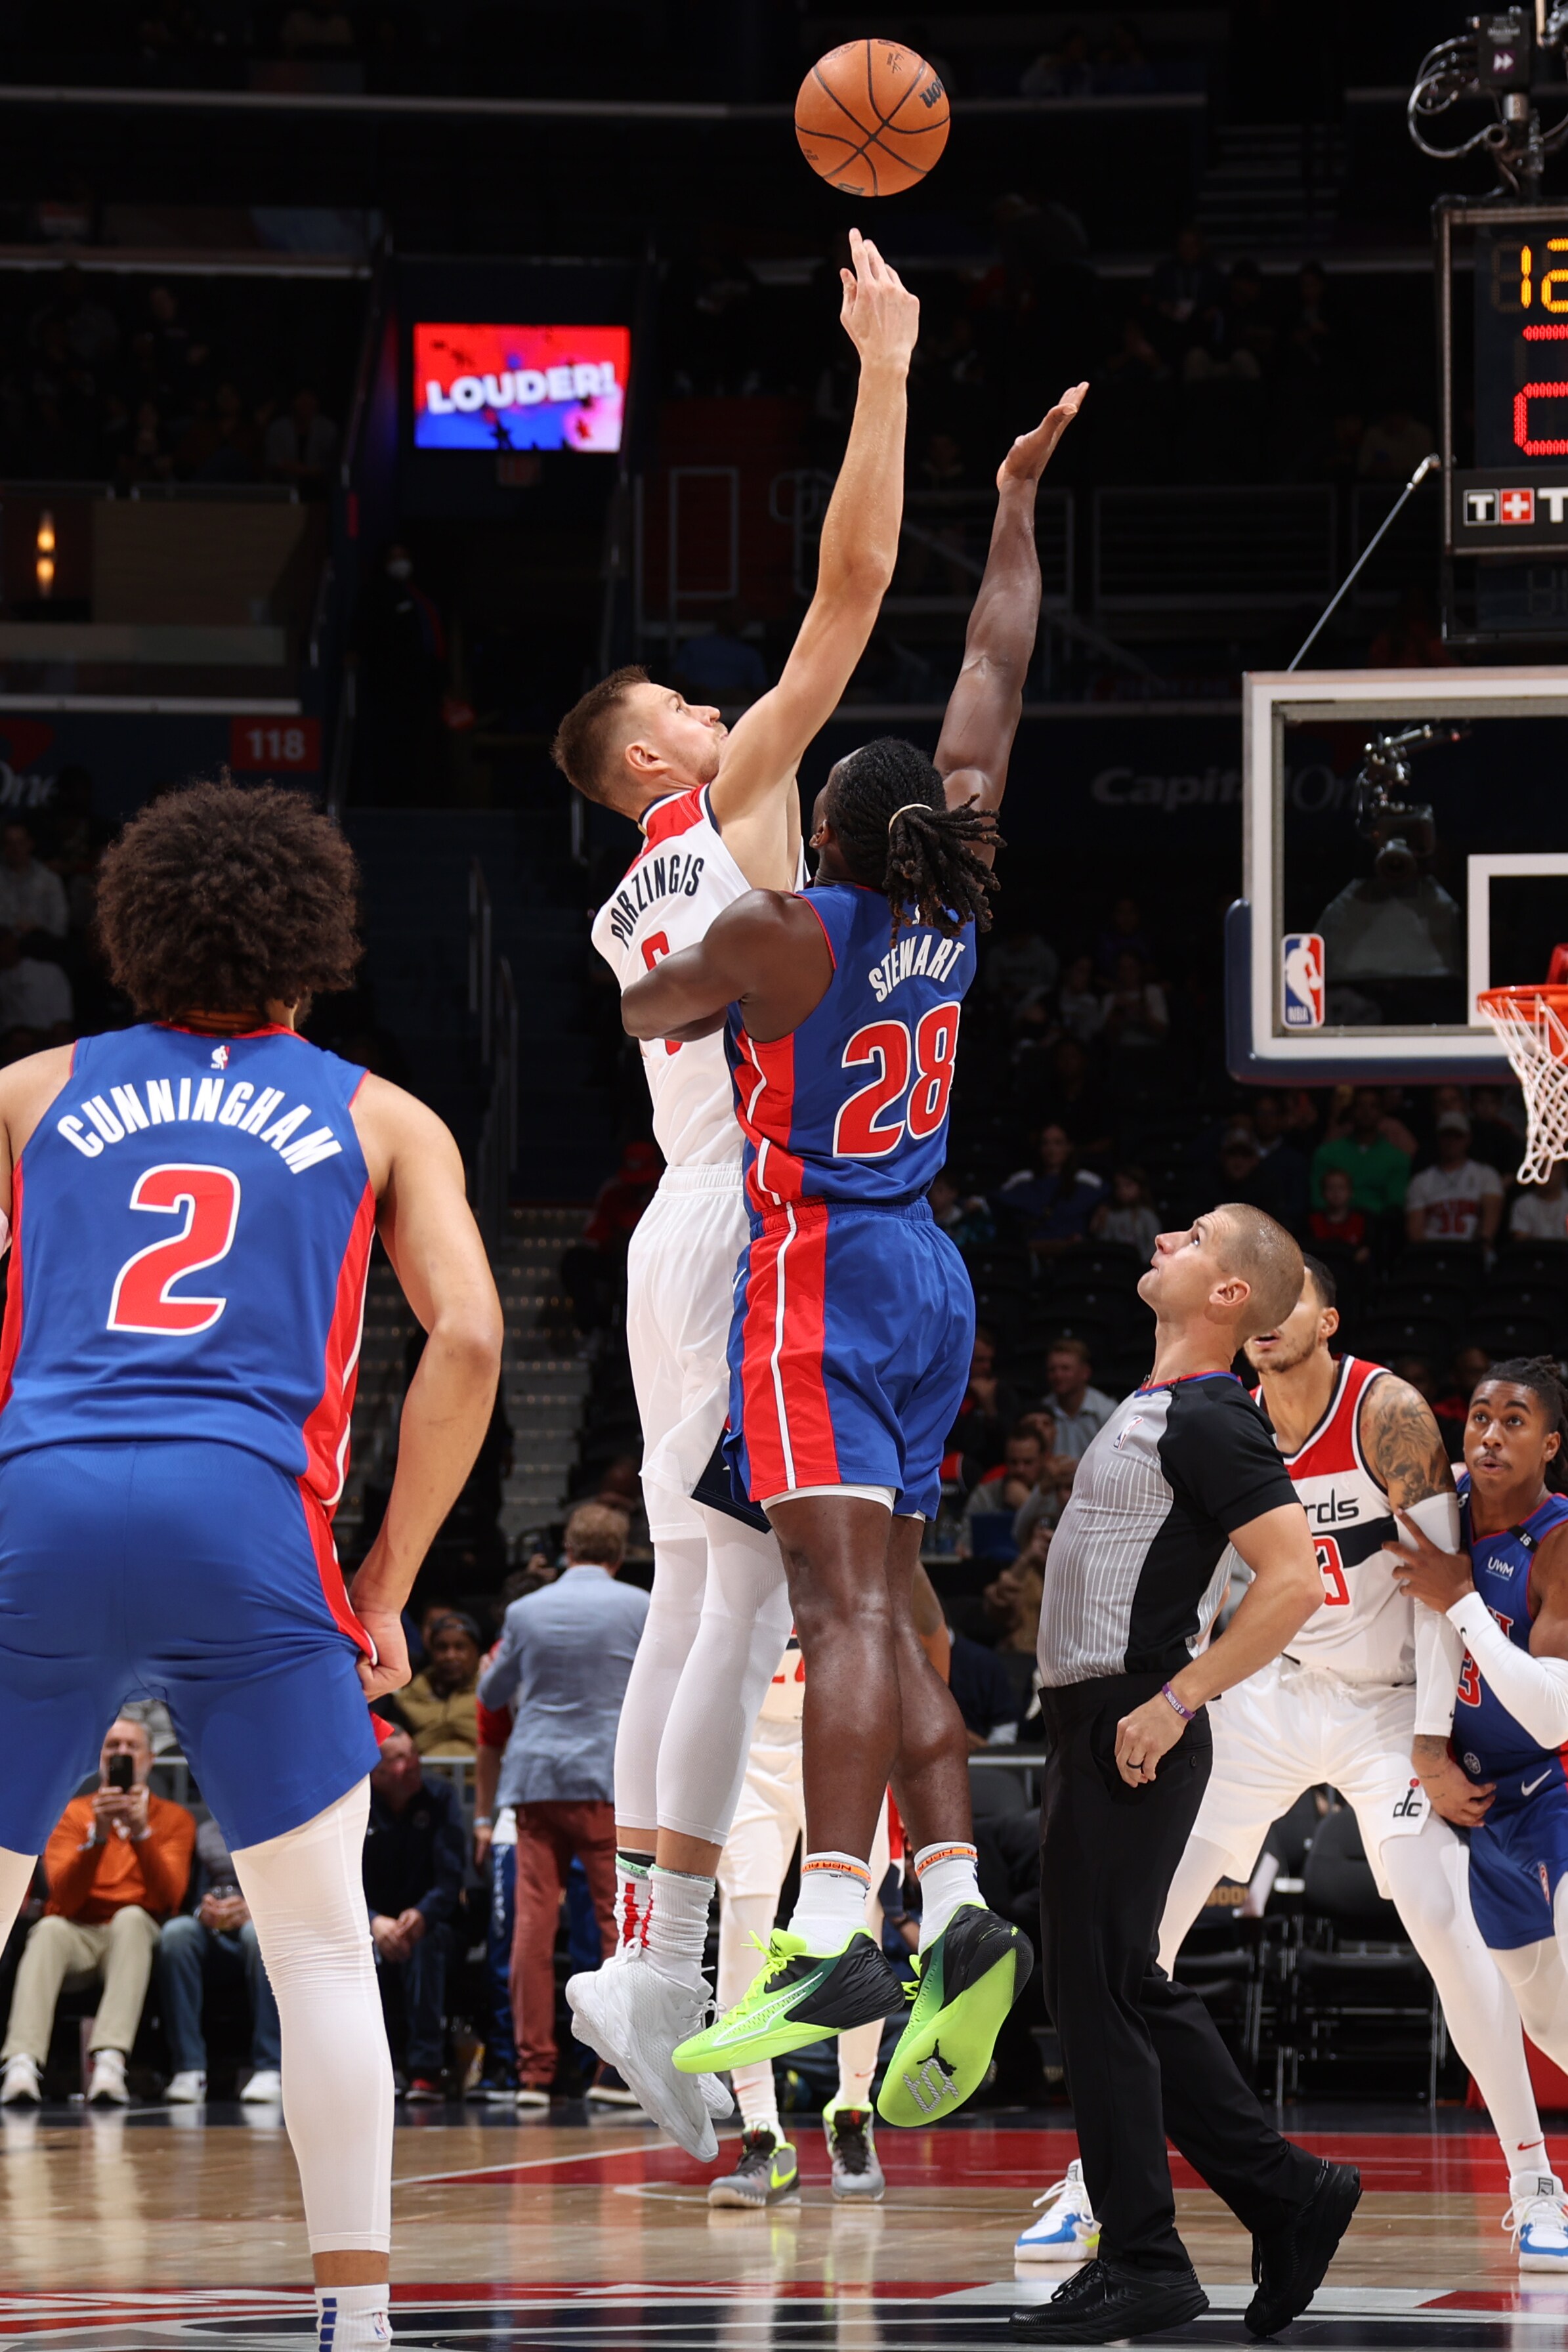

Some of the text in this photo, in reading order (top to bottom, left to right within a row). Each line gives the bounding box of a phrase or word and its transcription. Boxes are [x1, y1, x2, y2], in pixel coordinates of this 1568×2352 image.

[426, 361, 616, 415] LOUDER!
[247, 727, 305, 761] 118
[611, 854, 704, 951] PORZINGIS
[868, 935, 965, 1002] STEWART
[833, 1001, 961, 1158] 28
[57, 1077, 342, 1174] CUNNINGHAM
[106, 1163, 241, 1336] 2
[1488, 1556, 1514, 1577] UWM
